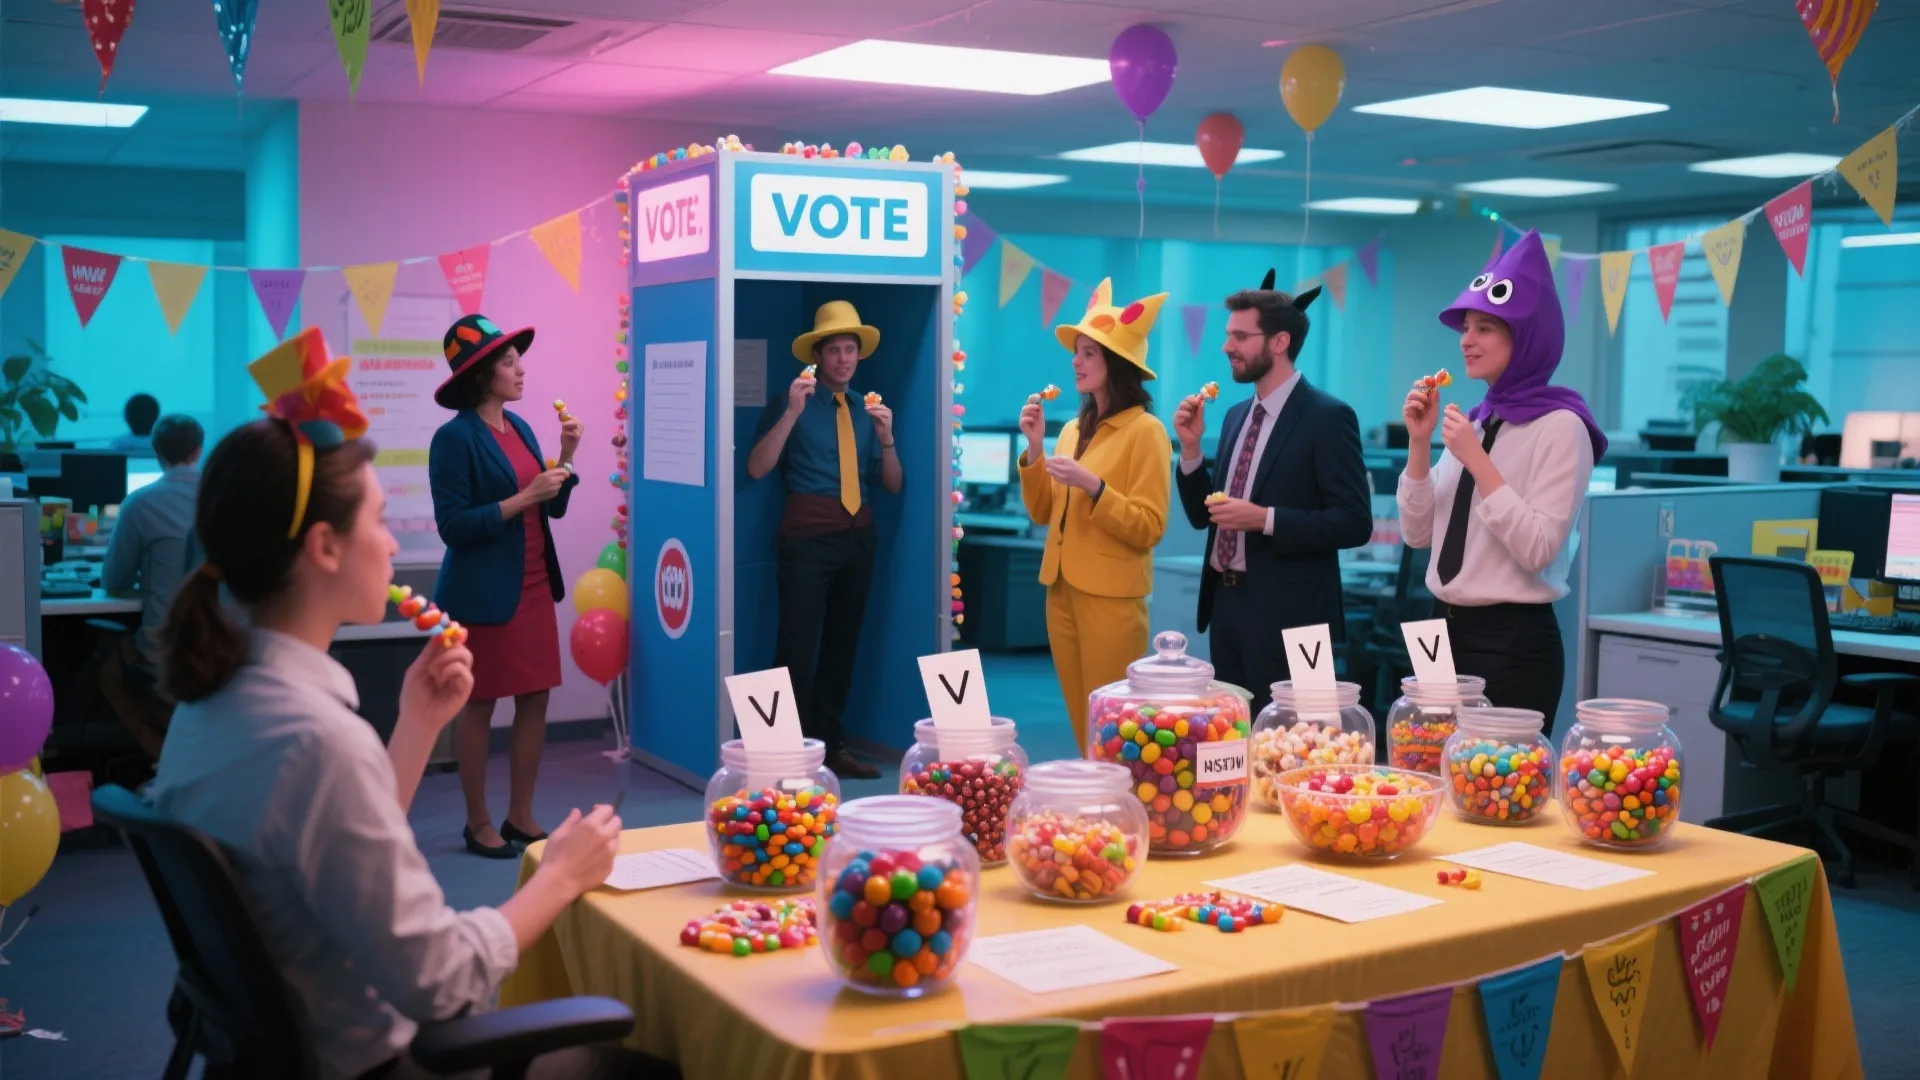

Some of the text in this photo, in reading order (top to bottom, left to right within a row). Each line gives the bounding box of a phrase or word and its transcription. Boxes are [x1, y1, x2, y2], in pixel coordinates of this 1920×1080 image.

[771, 192, 909, 242] VOTE
[1298, 641, 1321, 670] V
[1417, 634, 1440, 662] V
[938, 670, 970, 705] V
[747, 690, 780, 728] V
